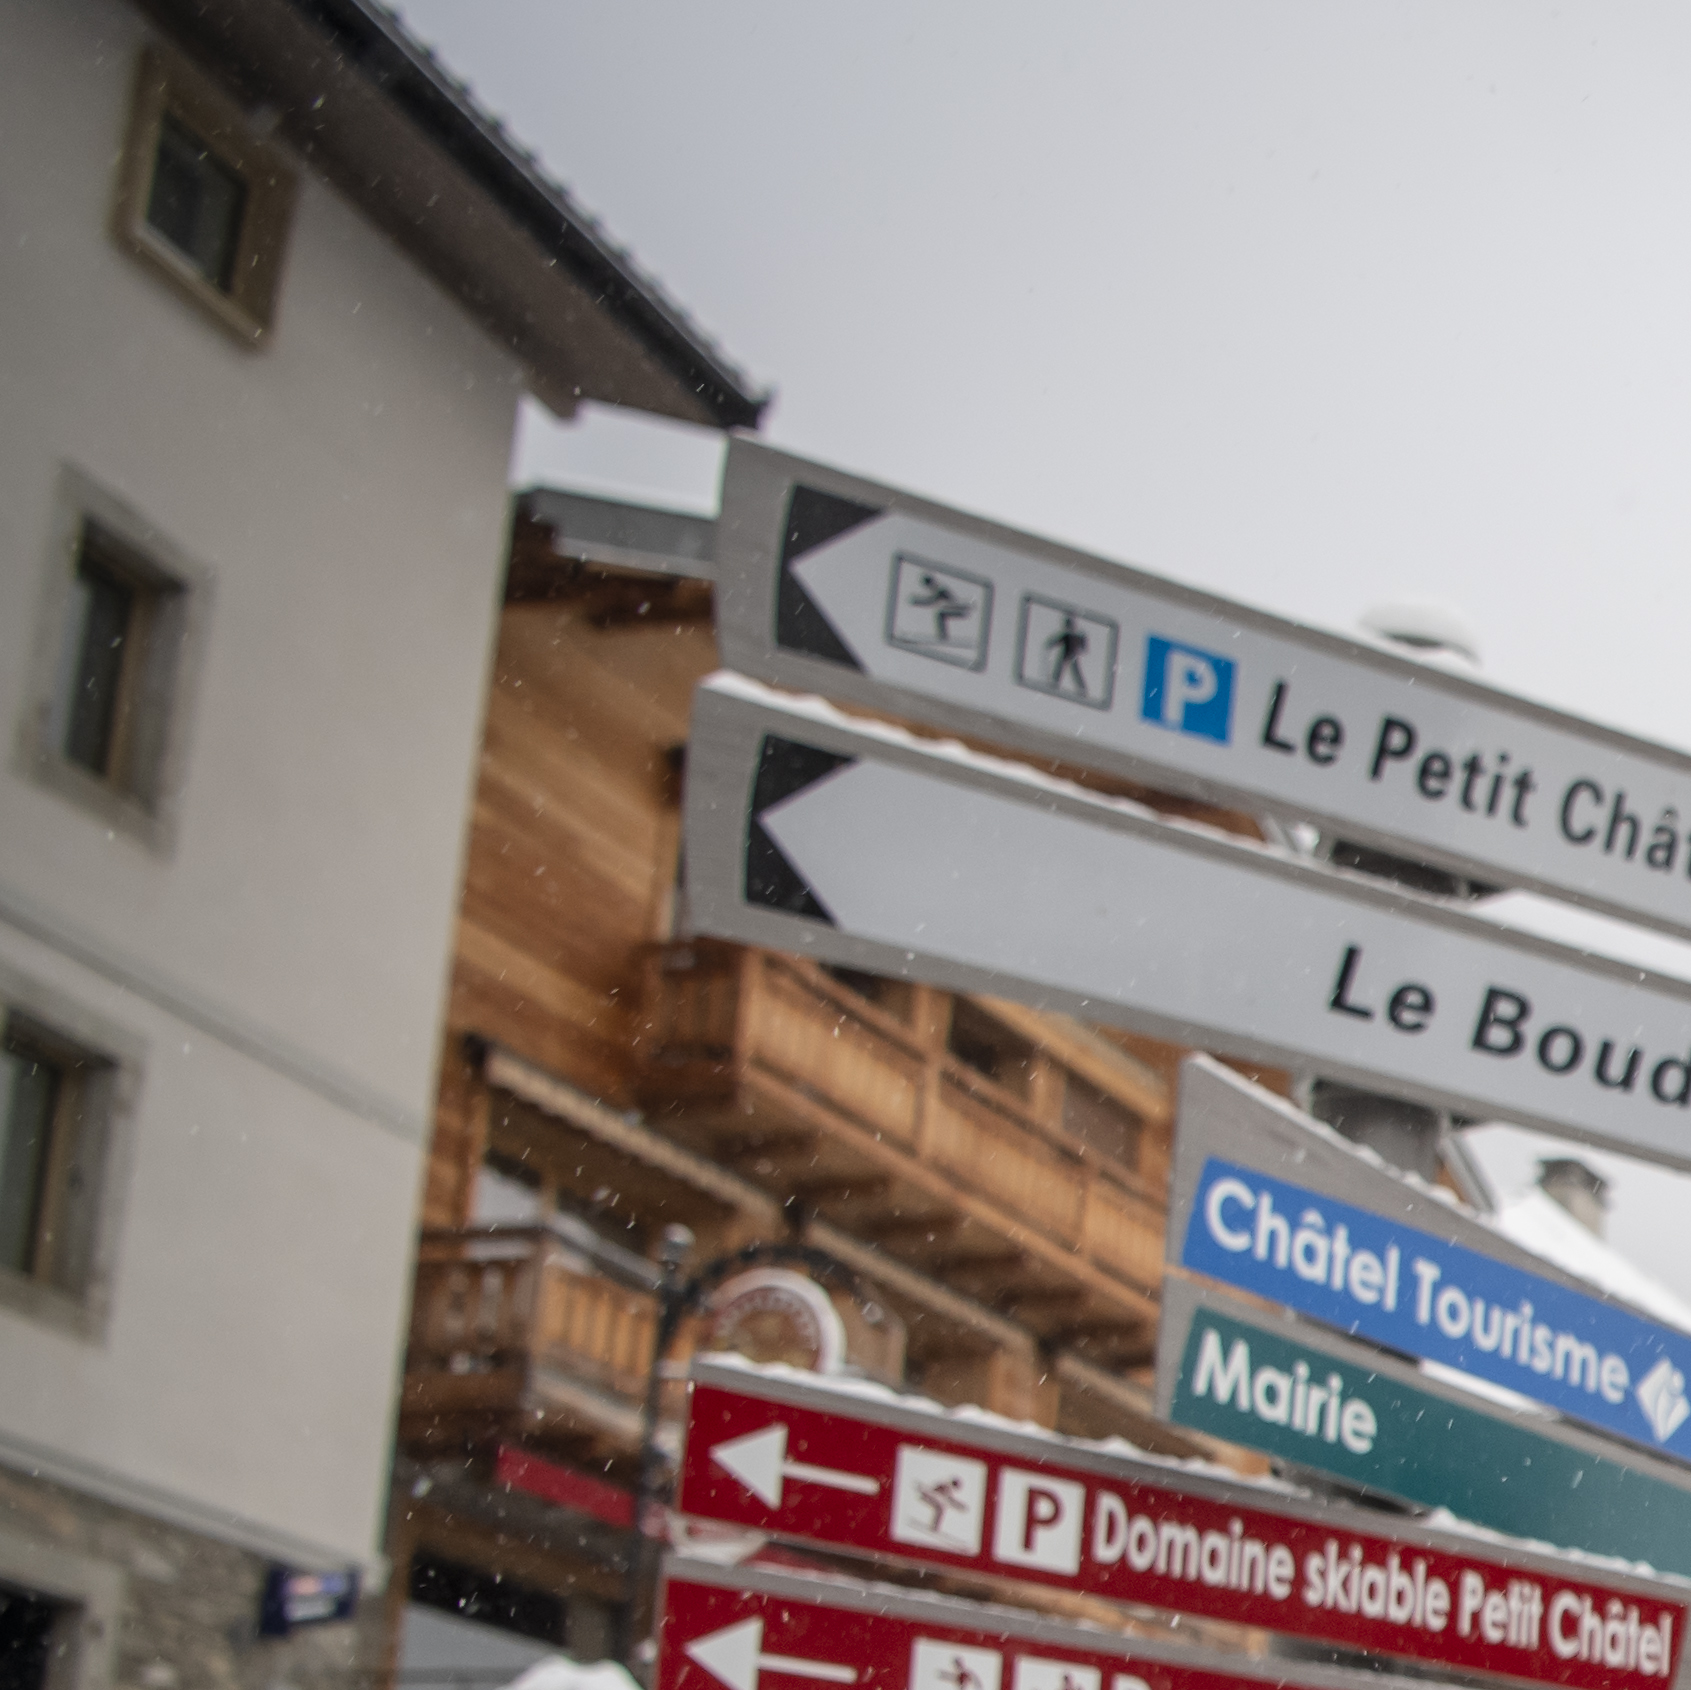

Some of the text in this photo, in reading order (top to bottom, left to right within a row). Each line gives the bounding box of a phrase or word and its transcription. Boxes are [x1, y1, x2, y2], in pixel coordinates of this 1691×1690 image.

[1259, 678, 1347, 767] Le
[1368, 712, 1535, 828] Petit
[1328, 943, 1435, 1034] Le
[1205, 1176, 1631, 1405] Châtel Tourisme
[1192, 1327, 1378, 1455] Mairie
[1092, 1490, 1296, 1601] Domaine
[1302, 1539, 1452, 1633] skiable
[1458, 1570, 1544, 1650] Petit
[1547, 1590, 1674, 1678] Châtel
